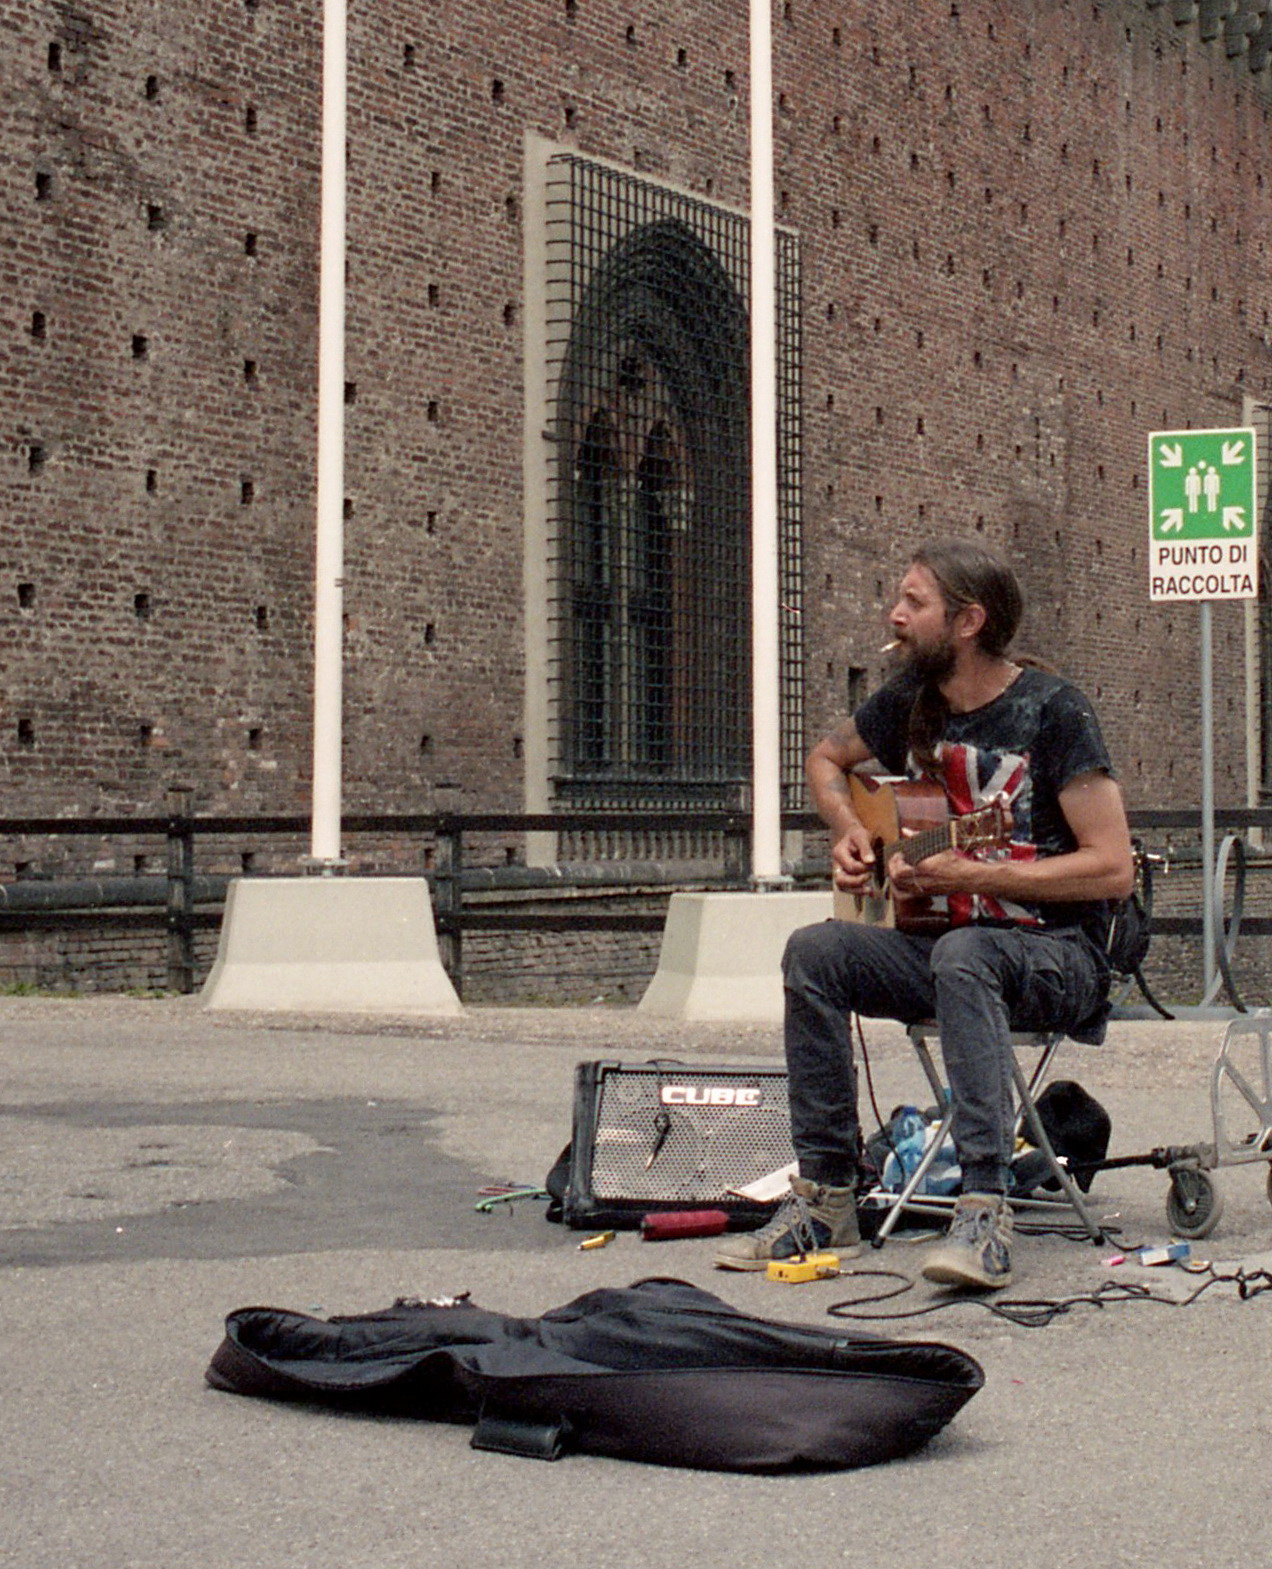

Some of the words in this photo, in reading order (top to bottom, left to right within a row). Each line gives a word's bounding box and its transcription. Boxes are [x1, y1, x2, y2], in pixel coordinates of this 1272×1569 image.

[1158, 545, 1223, 566] PUNTO
[1229, 544, 1248, 563] DI
[1152, 574, 1253, 596] RACCOLTA
[661, 1086, 761, 1106] CUBE
